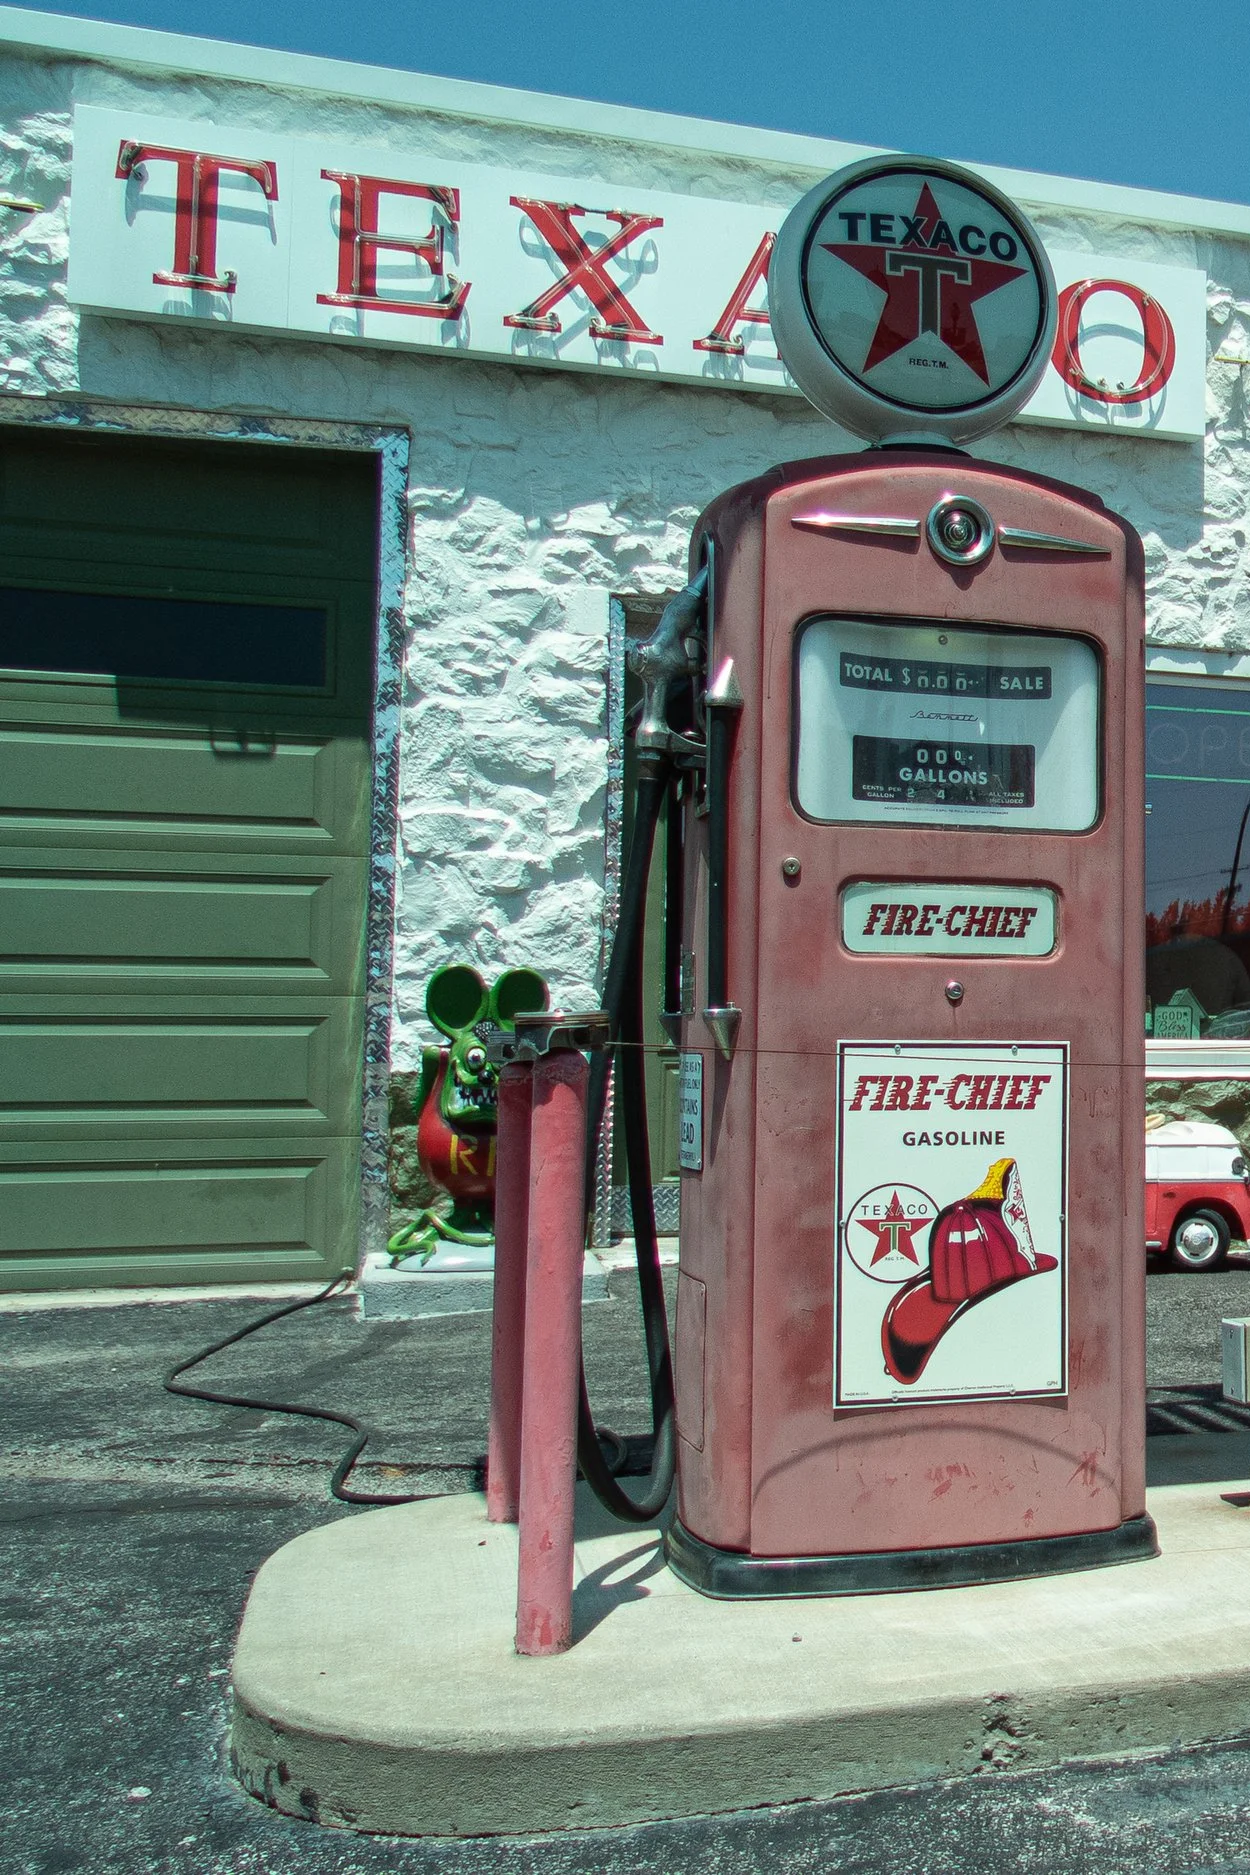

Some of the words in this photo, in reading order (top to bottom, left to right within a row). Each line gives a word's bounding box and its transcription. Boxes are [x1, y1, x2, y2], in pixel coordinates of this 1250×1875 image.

[838, 210, 1019, 263] TEXACO
[114, 138, 1176, 404] TEXAO
[844, 662, 894, 683] TOTAL
[999, 676, 1044, 690] SALE
[899, 767, 988, 785] GALLONS
[862, 784, 884, 792] CENTS
[867, 791, 895, 799] GALLON
[862, 903, 1038, 938] FIRE-CHIEF
[1162, 1011, 1183, 1021] GOD
[848, 1073, 1052, 1112] FIRE-CHIEF
[902, 1130, 1006, 1147] GASOLINE
[860, 1203, 928, 1216] TEXACO
